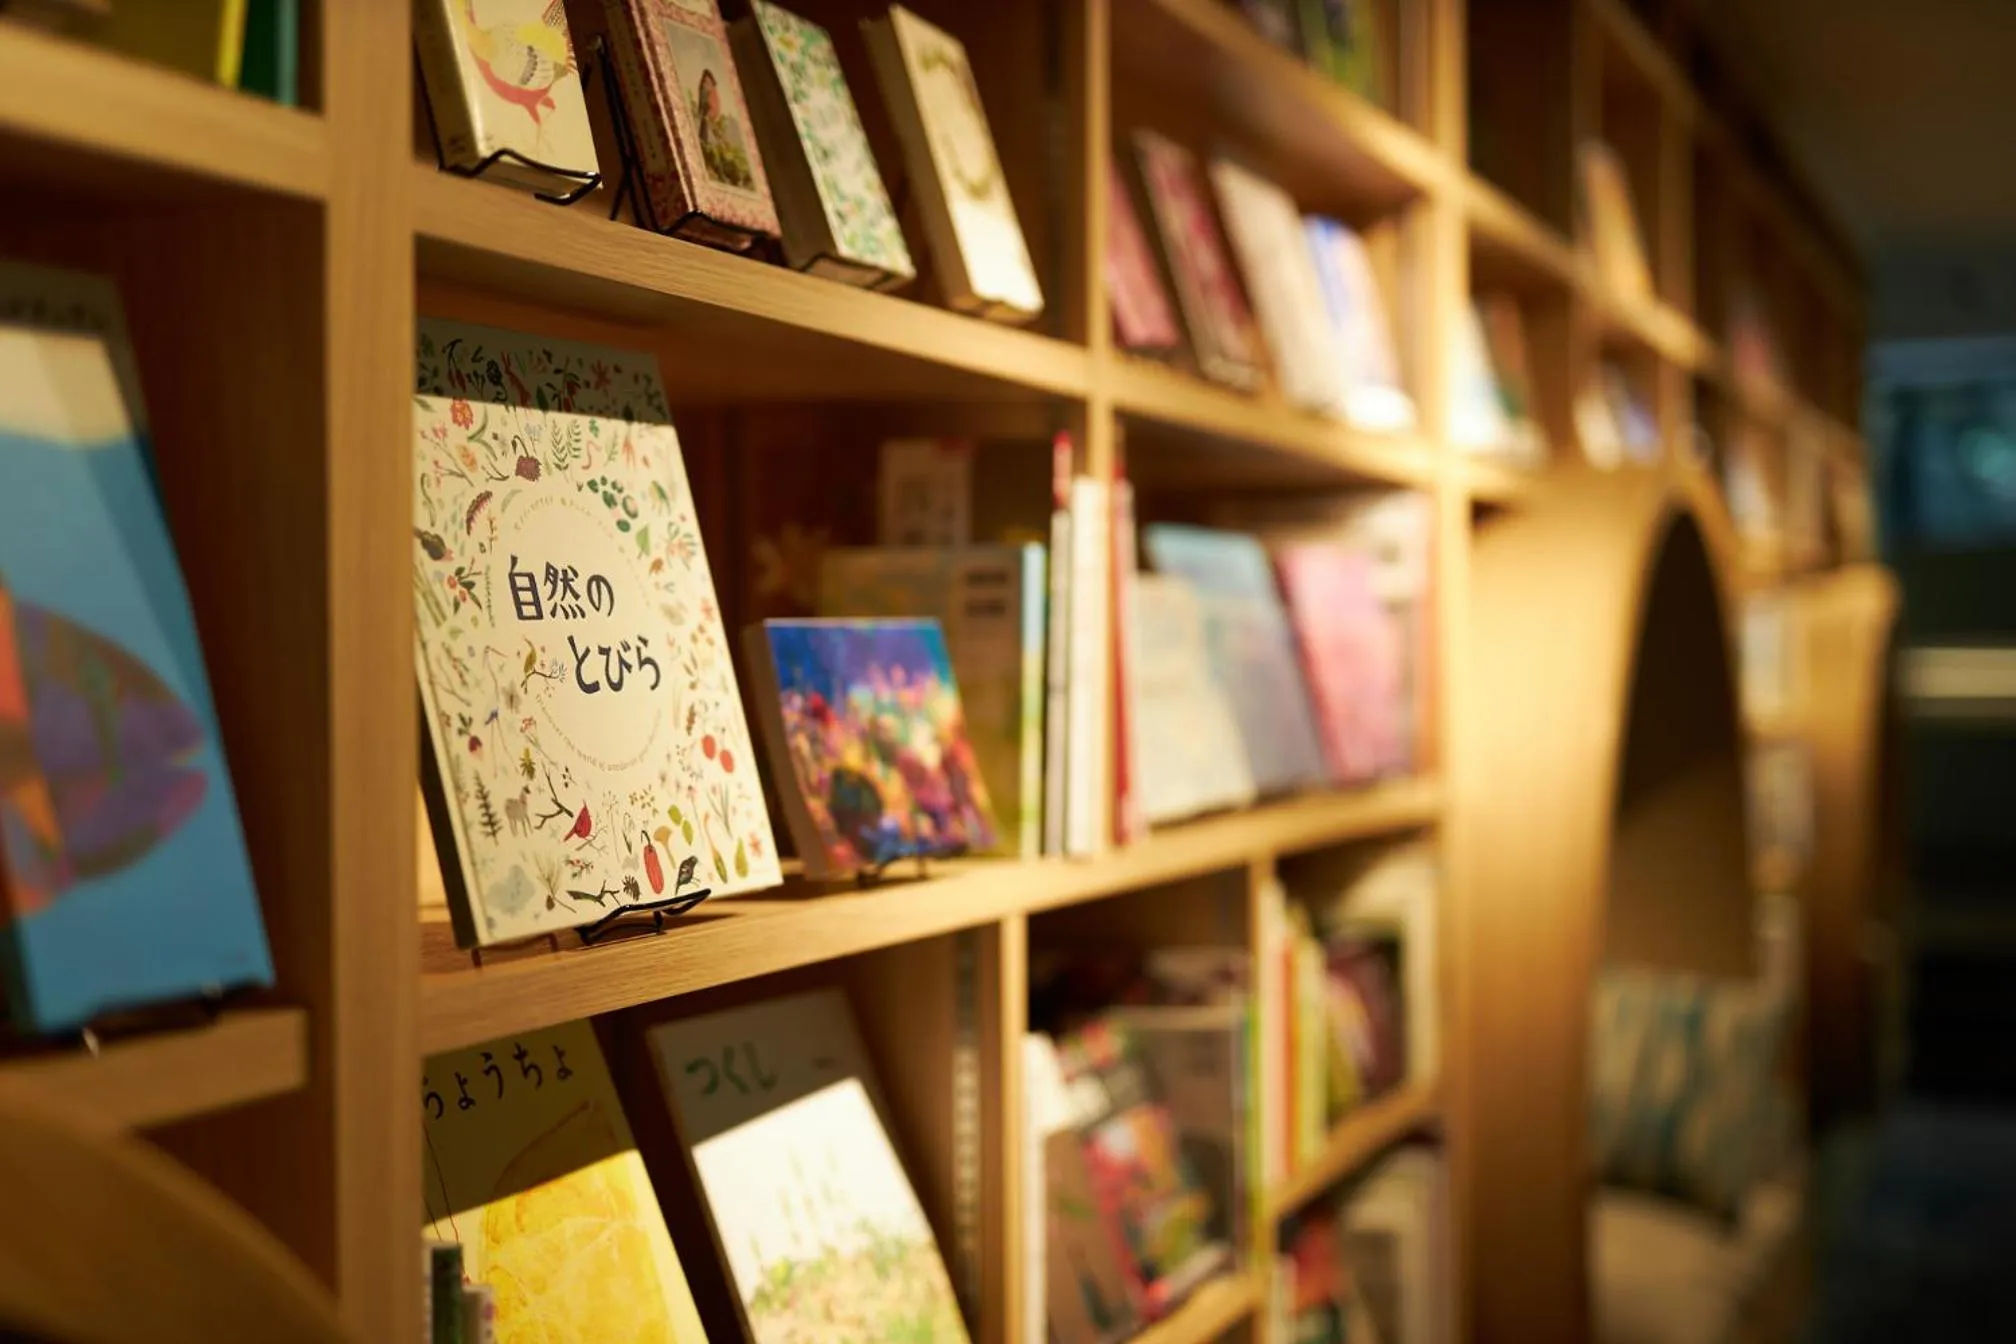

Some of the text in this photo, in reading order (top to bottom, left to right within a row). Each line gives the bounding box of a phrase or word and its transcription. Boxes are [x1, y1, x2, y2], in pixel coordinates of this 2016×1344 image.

[508, 554, 615, 621] 自然の
[567, 634, 661, 694] とびら
[684, 1042, 778, 1095] つくし
